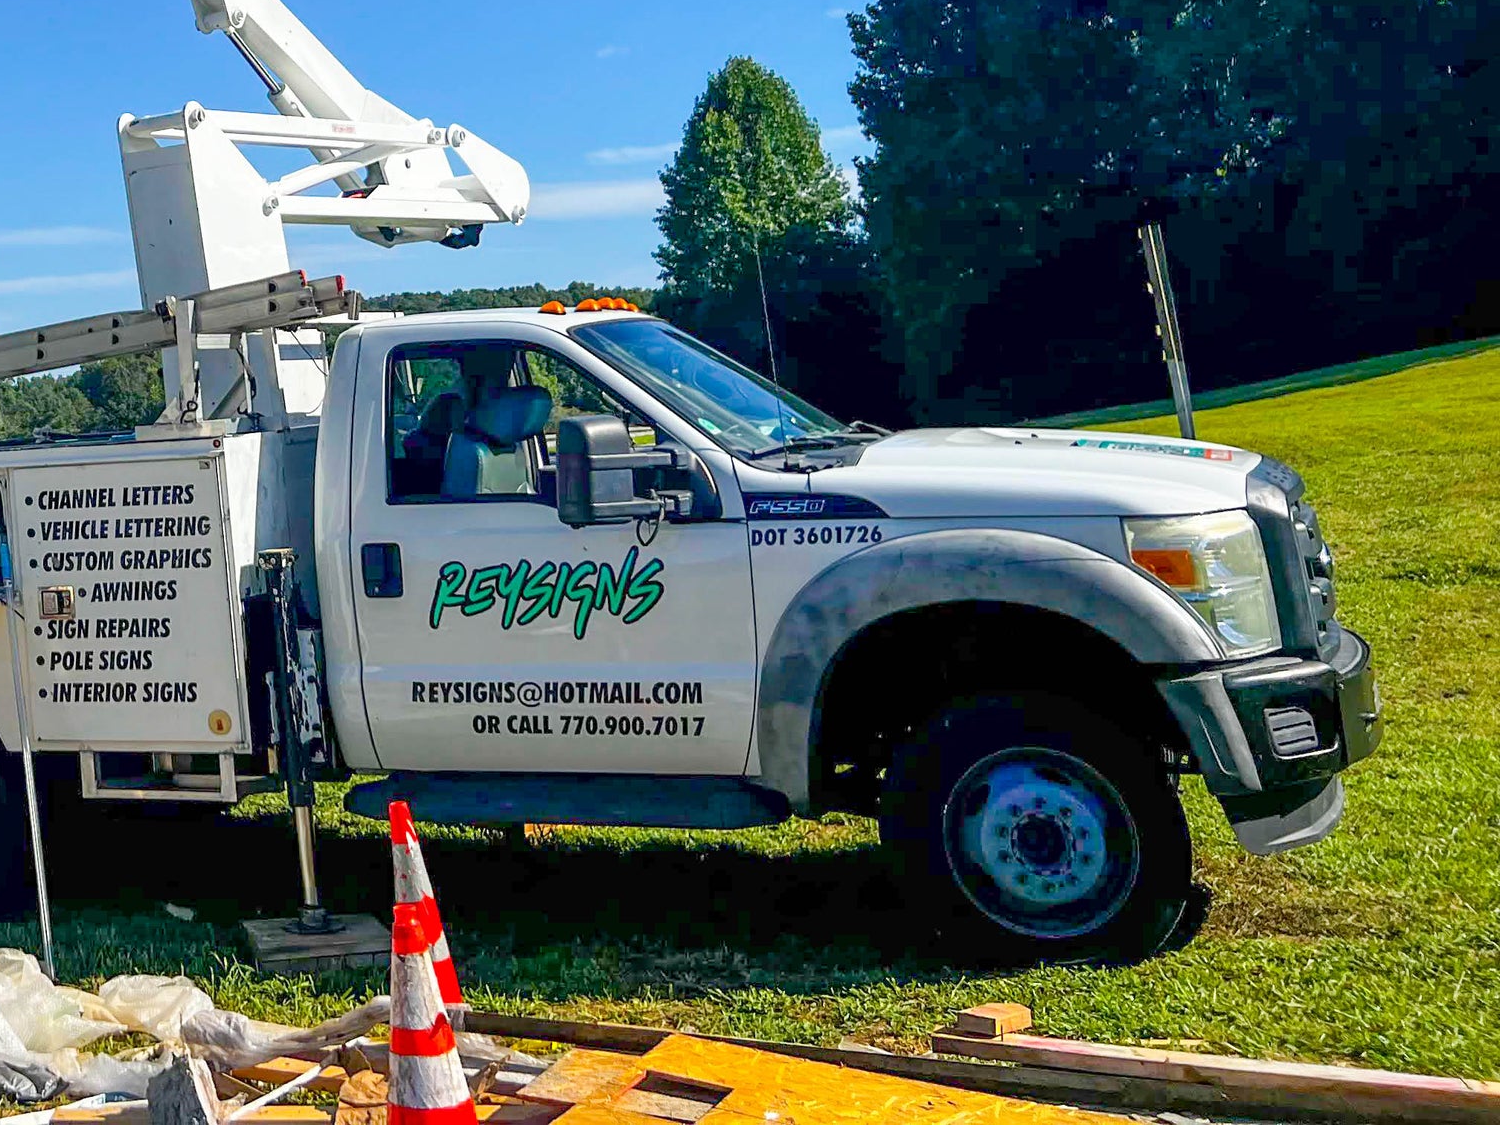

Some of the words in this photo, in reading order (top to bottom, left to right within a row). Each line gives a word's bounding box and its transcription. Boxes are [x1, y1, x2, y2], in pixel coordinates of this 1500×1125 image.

[38, 487, 116, 511] CHANNEL
[122, 484, 194, 507] LETTERS
[40, 518, 110, 541] VEHICLE
[114, 515, 212, 539] LETTERING
[751, 528, 788, 546] DOT
[793, 525, 883, 545] 3601726
[42, 550, 114, 573] CUSTOM
[120, 547, 212, 570] GRAPHICS
[90, 579, 178, 603] AWNINGS
[429, 545, 665, 640] REYSIGNS
[47, 618, 90, 640] SIGN
[95, 617, 171, 639] REPAIRS
[49, 650, 93, 671] POLE
[99, 649, 153, 671] SIGNS
[52, 682, 137, 703] INTERIOR
[142, 682, 198, 703] SIGNS
[411, 681, 703, 708] REYSIGNS@HOTMAIL.COM
[472, 714, 501, 734] OR
[506, 714, 554, 735] CALL
[559, 715, 706, 737] 770.900.7017
